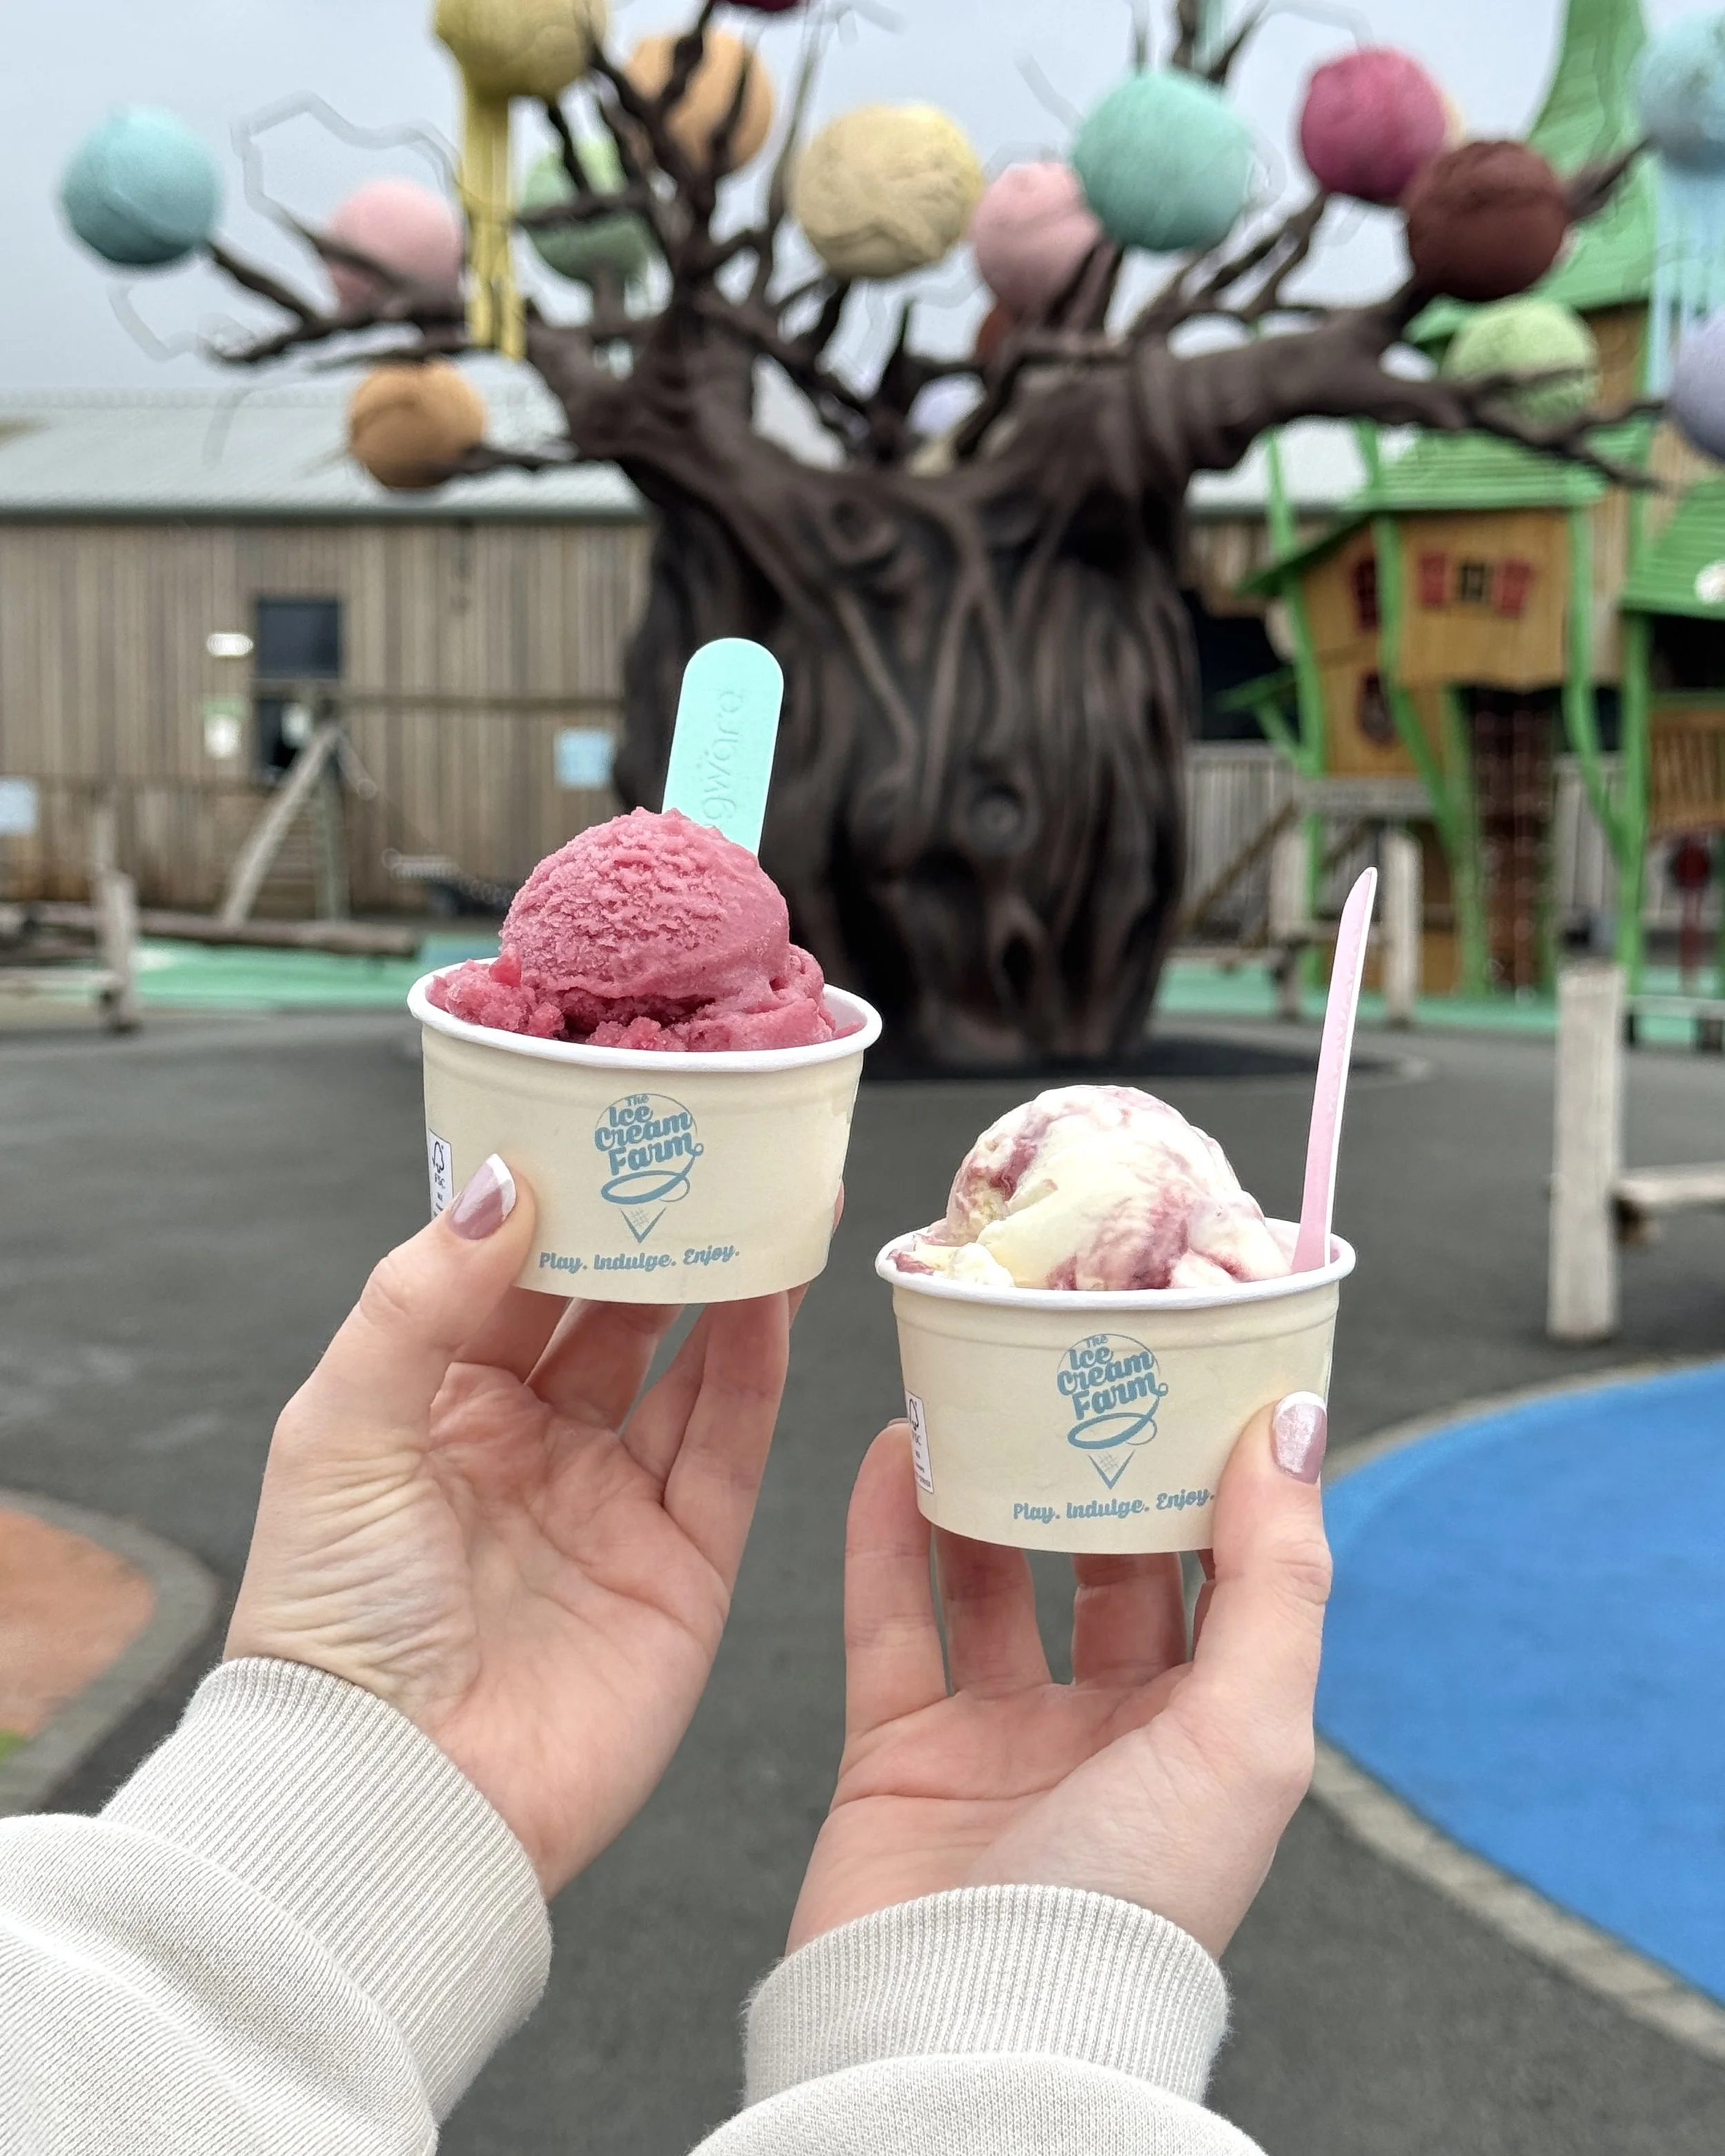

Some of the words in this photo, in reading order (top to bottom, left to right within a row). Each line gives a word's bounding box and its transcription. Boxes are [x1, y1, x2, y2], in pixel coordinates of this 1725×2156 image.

[702, 690, 744, 827] gware
[609, 1106, 653, 1128] Ice
[627, 1094, 649, 1107] The
[595, 1112, 693, 1151] Cream
[609, 1132, 704, 1176] Farm
[540, 1252, 587, 1274] Play.
[593, 1253, 677, 1272] Indulge.
[683, 1245, 740, 1266] Enjoy.
[1069, 1346, 1114, 1370] Ice
[1086, 1334, 1108, 1348] The
[1057, 1351, 1155, 1396] Cream
[1072, 1372, 1169, 1420] Farm
[1014, 1503, 1061, 1524] Play.
[1066, 1499, 1150, 1519] Indulge.
[1156, 1489, 1214, 1510] Enjoy.
